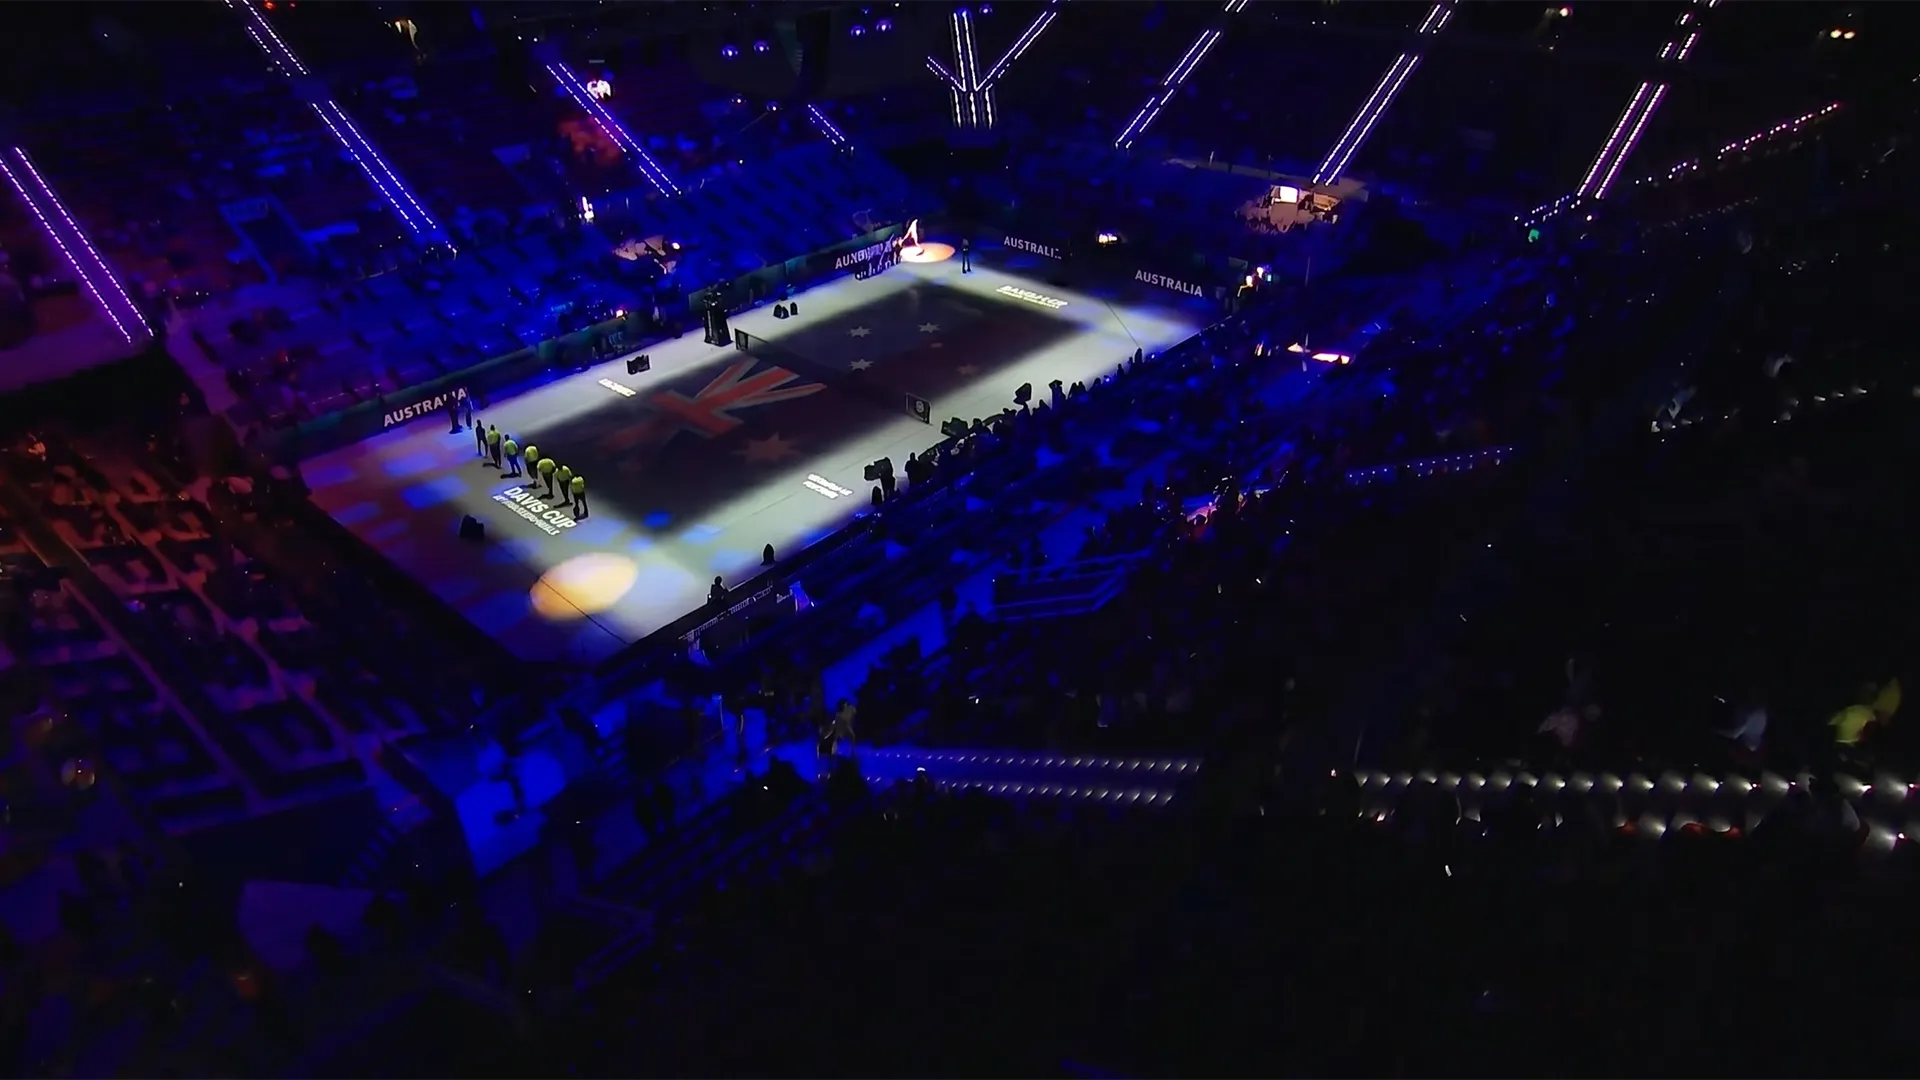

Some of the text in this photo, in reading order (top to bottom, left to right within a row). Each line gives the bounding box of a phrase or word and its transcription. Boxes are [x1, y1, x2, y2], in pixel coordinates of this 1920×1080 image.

[1134, 269, 1203, 298] AUSTRALIA
[503, 486, 549, 513] DAVIS
[542, 510, 577, 528] CUP
